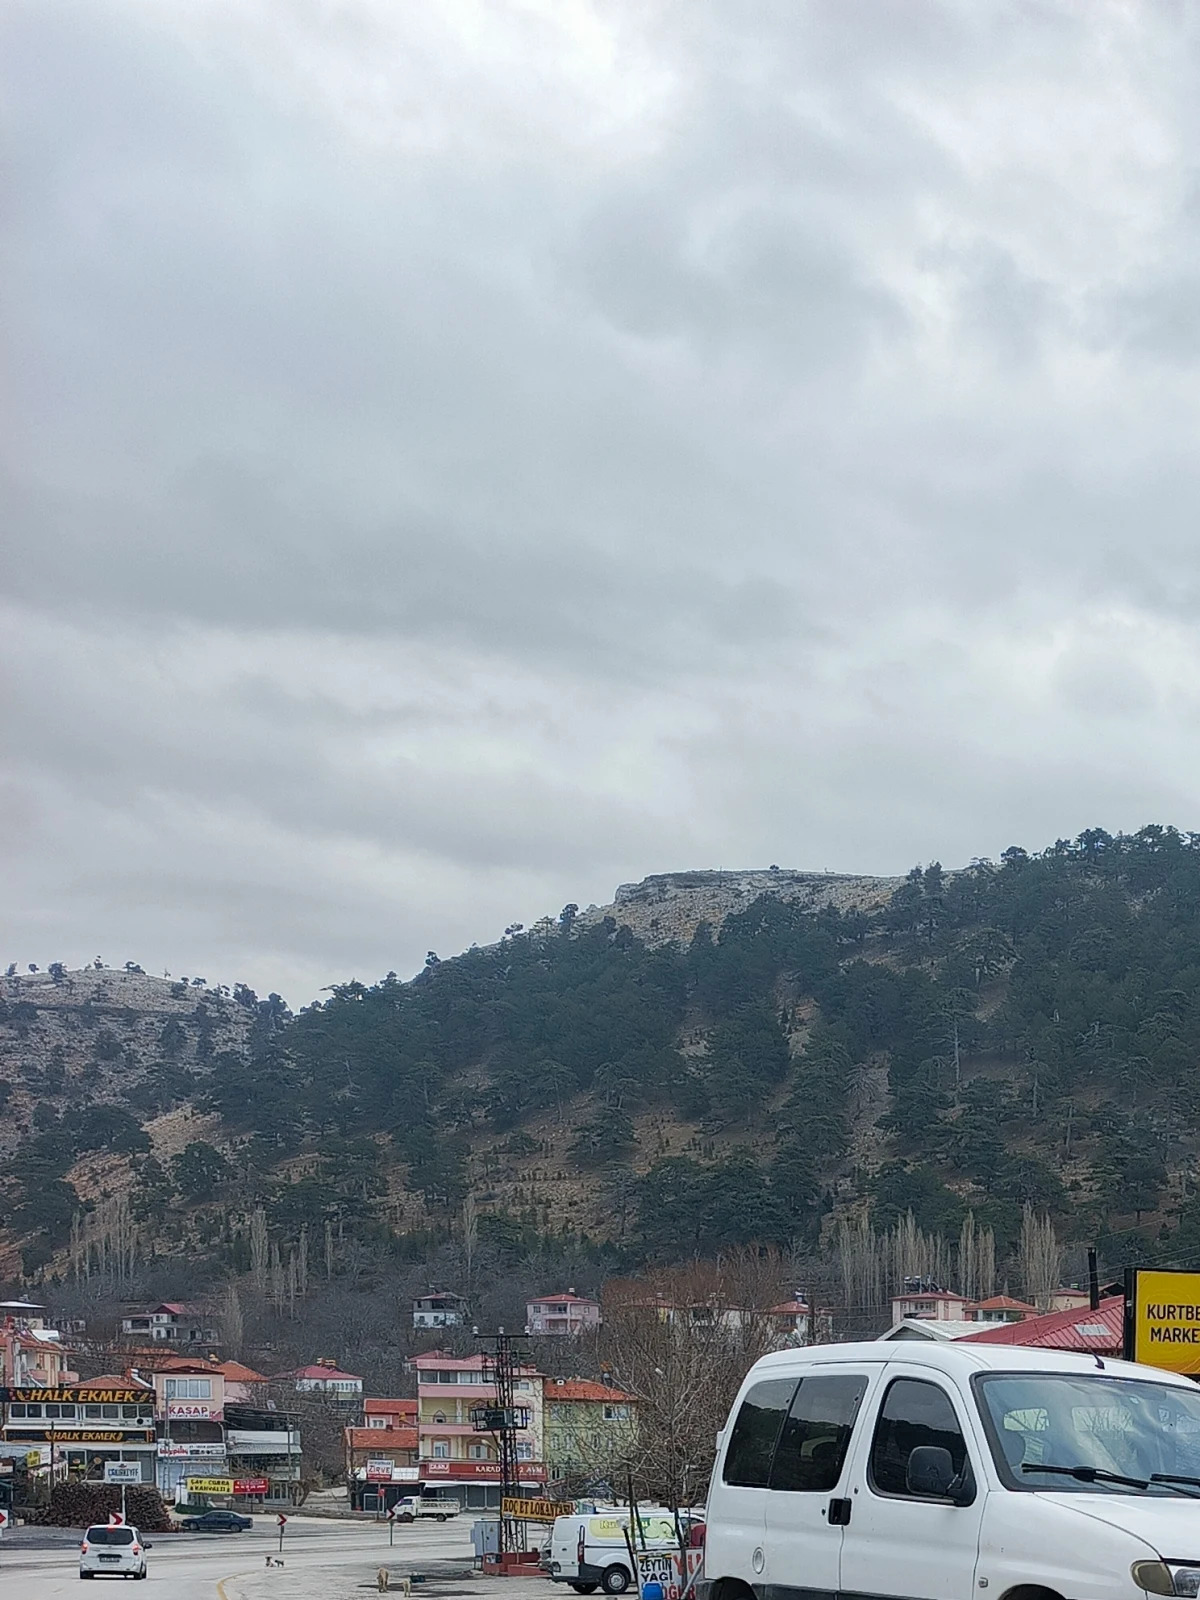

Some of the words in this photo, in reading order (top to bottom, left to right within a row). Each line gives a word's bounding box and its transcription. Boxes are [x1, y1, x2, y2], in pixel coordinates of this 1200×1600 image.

[30, 1389, 74, 1402] HALK
[77, 1390, 135, 1402] EKMEK
[168, 1406, 208, 1414] KASAP
[53, 1431, 80, 1441] HALK
[81, 1431, 118, 1441] EKMEK
[503, 1499, 519, 1515] KOÇ
[519, 1501, 530, 1515] ET
